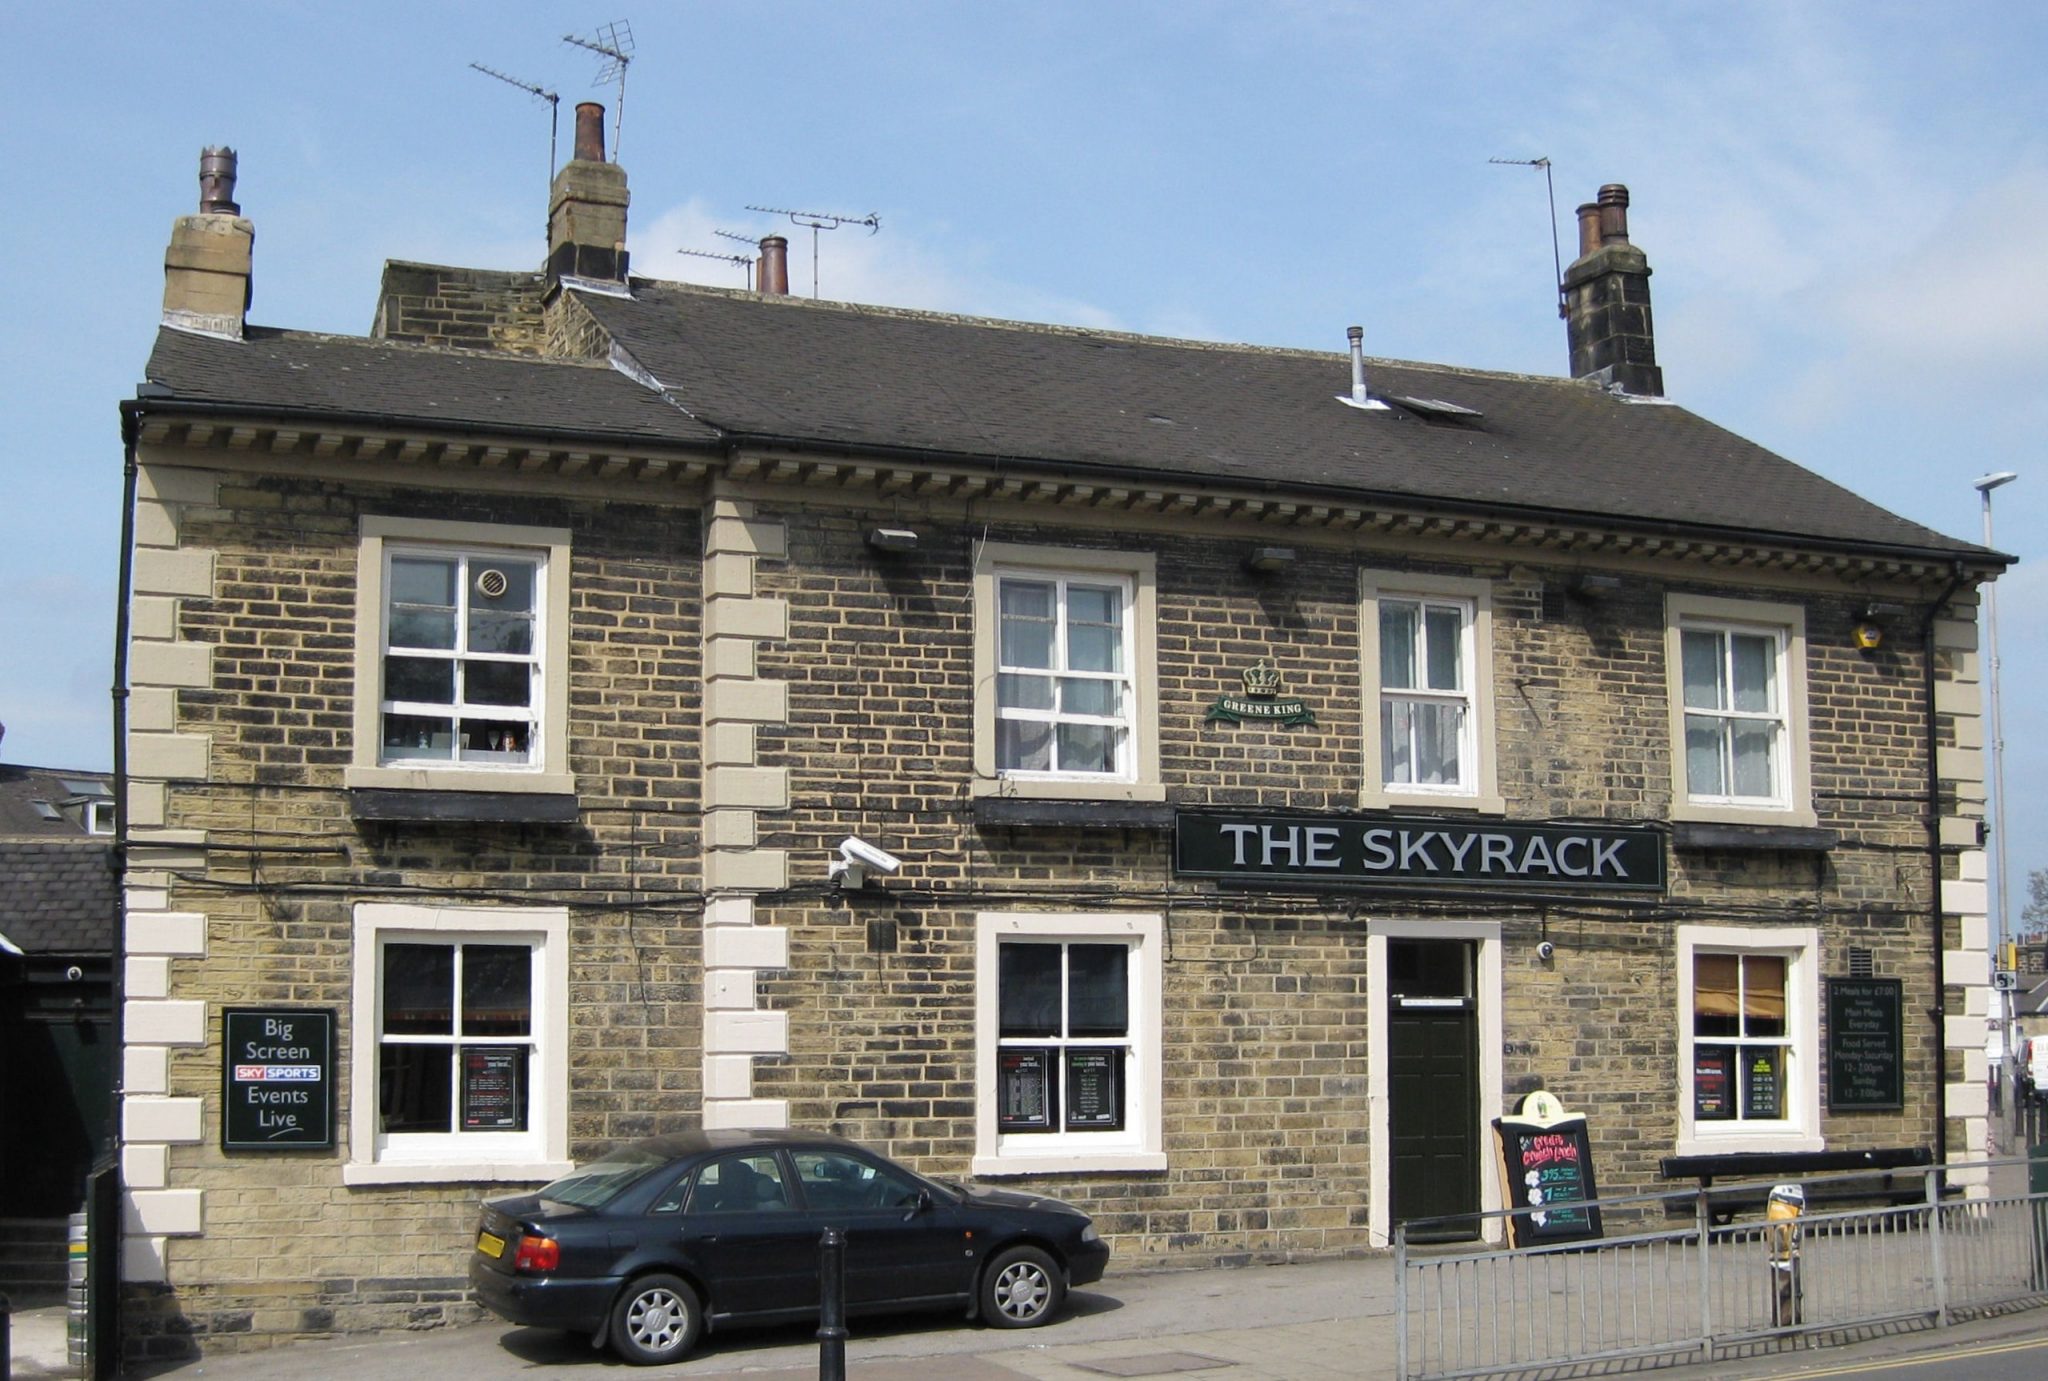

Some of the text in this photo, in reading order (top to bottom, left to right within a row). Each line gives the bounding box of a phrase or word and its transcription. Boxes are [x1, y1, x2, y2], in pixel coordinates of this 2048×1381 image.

[1223, 700, 1302, 715] GREENE KING
[1220, 823, 1630, 878] THE SKYRACK
[264, 1018, 294, 1042] Big
[246, 1041, 310, 1060] Screen
[1842, 1038, 1861, 1048] Food
[238, 1068, 318, 1079] SKY SPORTS
[247, 1086, 309, 1104] Events
[259, 1109, 297, 1127] Live
[1533, 1135, 1564, 1149] Credit
